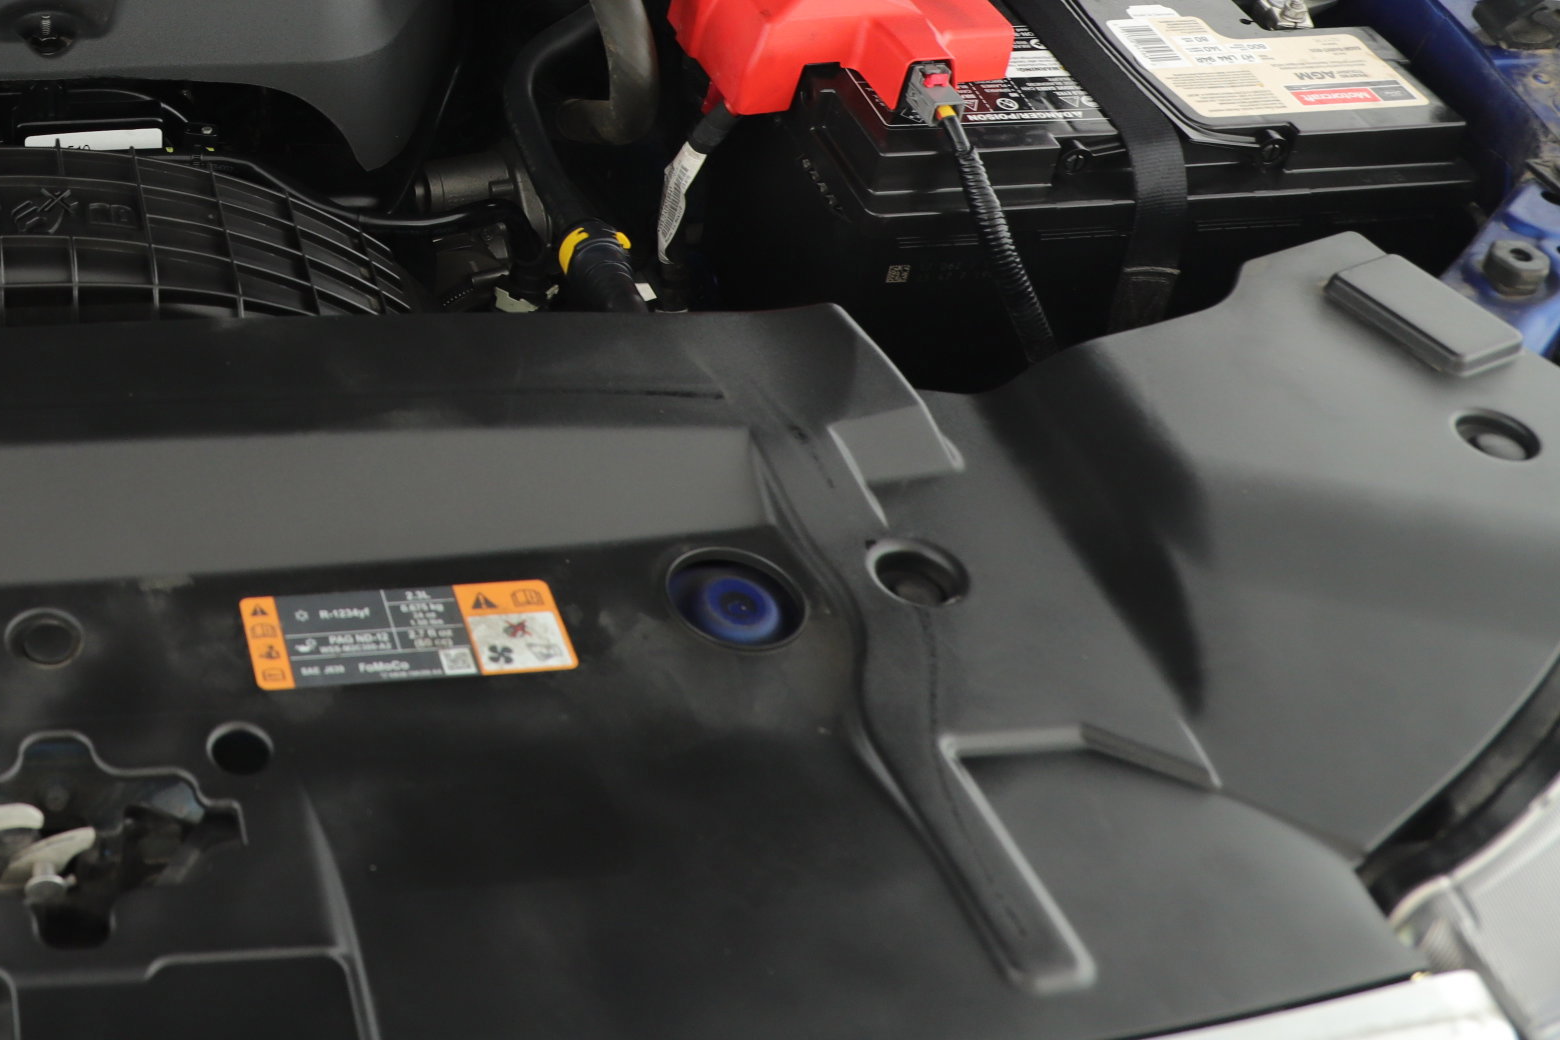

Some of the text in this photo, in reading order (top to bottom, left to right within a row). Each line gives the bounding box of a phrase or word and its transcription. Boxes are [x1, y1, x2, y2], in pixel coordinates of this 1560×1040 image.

[1293, 70, 1336, 81] AGM
[1299, 91, 1372, 103] Motorcraft
[967, 112, 1072, 122] DANGER/POISON
[318, 607, 370, 620] R-1234yf
[358, 660, 410, 673] FoMoCo
